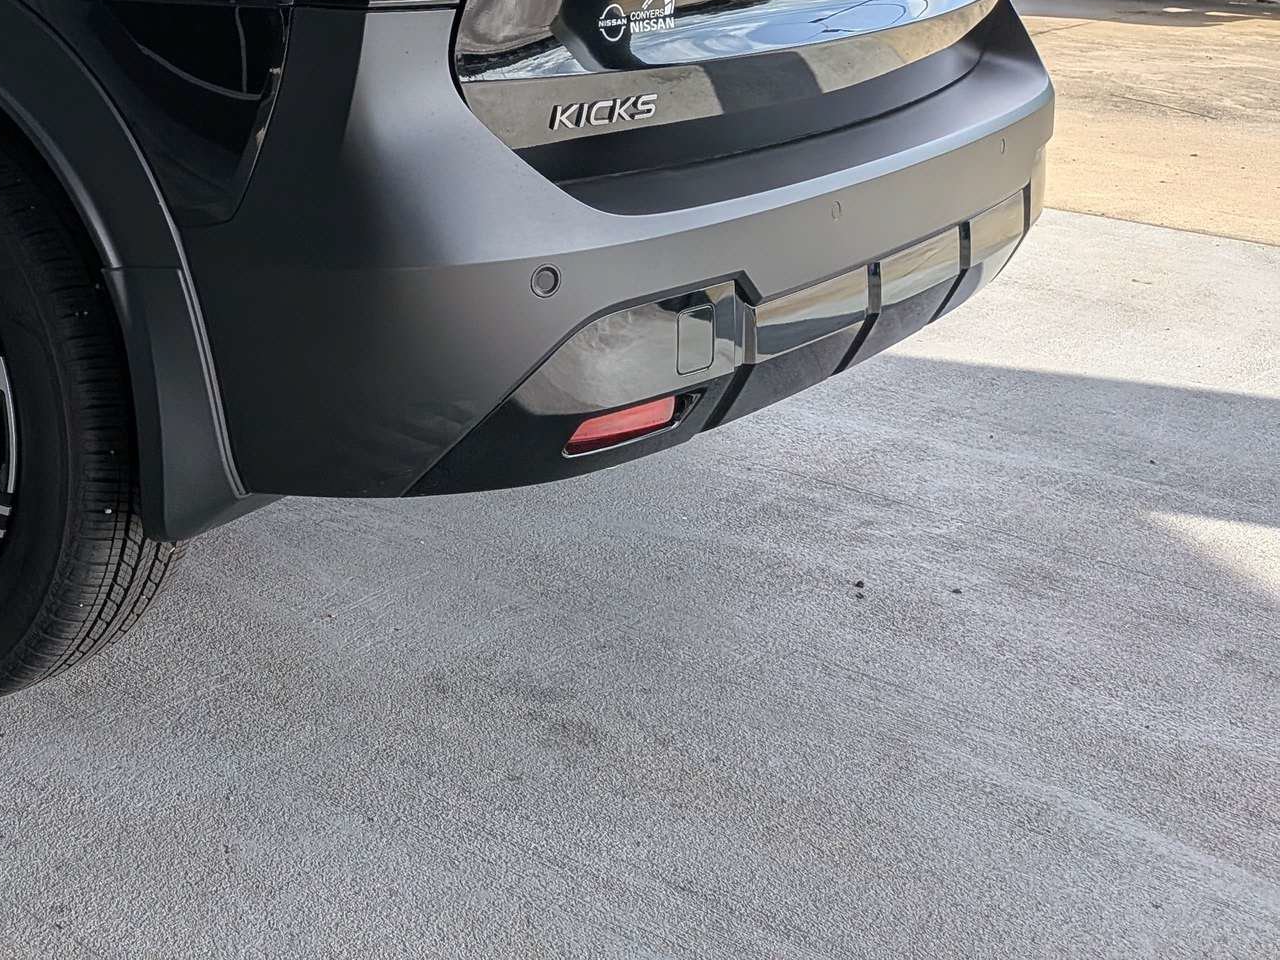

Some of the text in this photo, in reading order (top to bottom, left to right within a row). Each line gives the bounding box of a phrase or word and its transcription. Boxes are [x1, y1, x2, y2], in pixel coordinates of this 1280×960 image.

[630, 8, 664, 20] CONYERS
[598, 17, 675, 33] NISSAN NISSAN
[549, 94, 658, 130] KICKS
